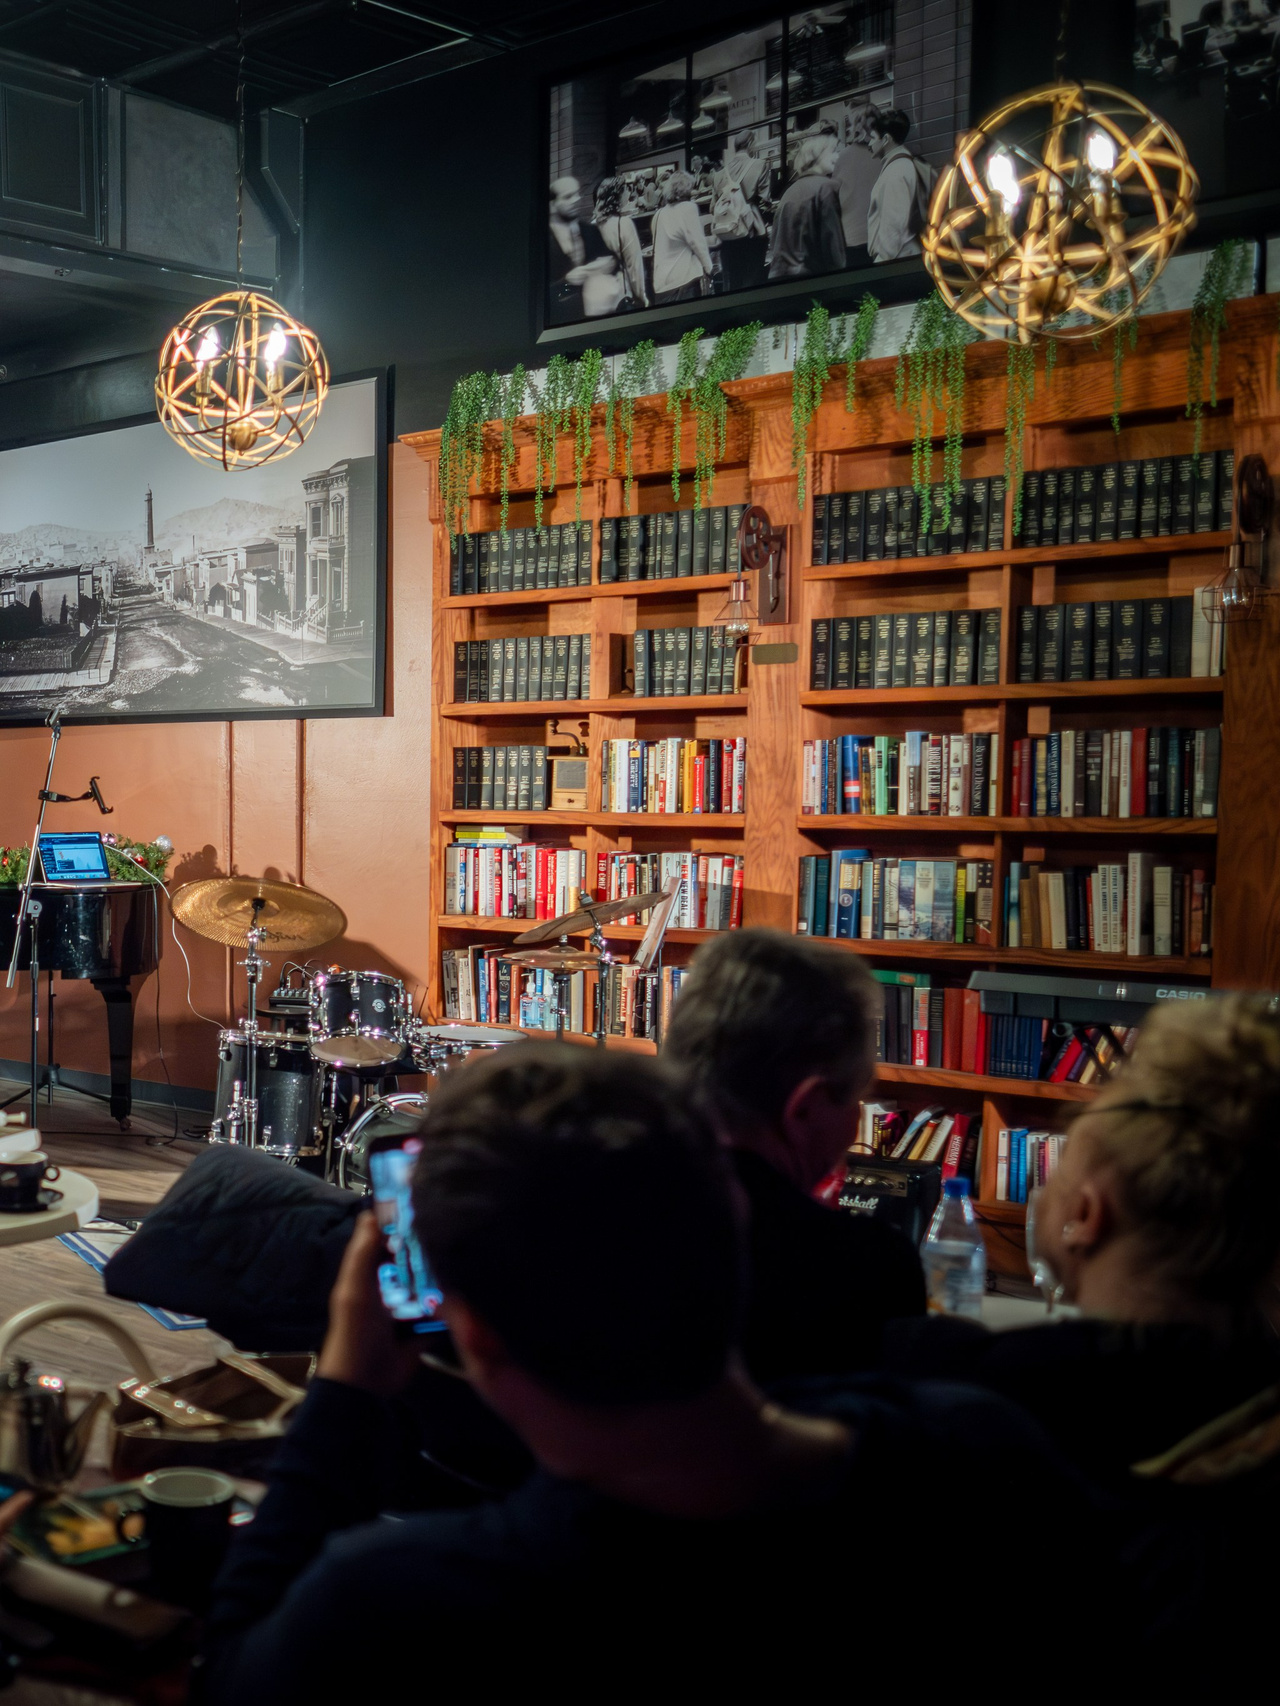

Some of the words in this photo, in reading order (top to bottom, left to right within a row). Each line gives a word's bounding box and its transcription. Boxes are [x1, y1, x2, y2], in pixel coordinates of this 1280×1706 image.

[928, 747, 941, 773] ROBERT
[928, 781, 940, 797] LEE
[598, 859, 607, 872] TED
[681, 865, 689, 879] NEW
[598, 873, 607, 890] CRUZ
[681, 880, 689, 895] NEW
[681, 896, 689, 911] DEAL
[1155, 988, 1207, 1001] CASIO
[946, 1135, 962, 1167] SHERMAN
